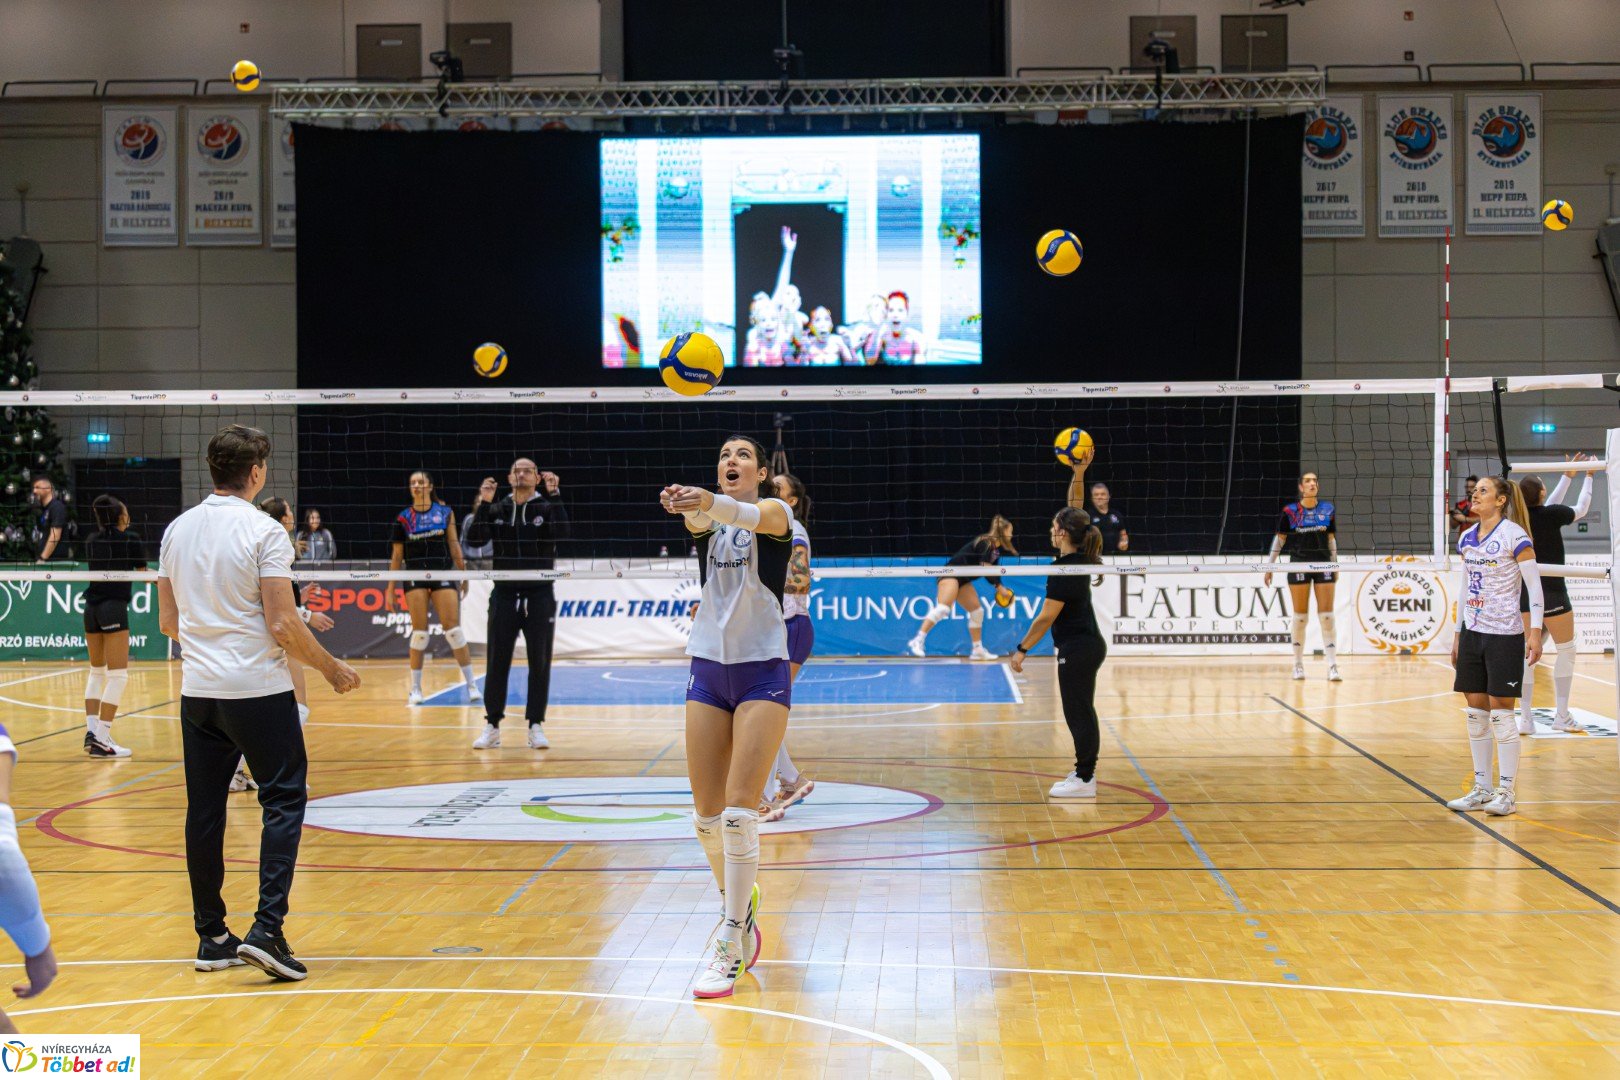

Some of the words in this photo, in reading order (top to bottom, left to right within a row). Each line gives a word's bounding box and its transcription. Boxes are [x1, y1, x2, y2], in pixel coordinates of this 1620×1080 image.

[1316, 182, 1336, 191] 2017
[1494, 180, 1514, 189] 2019
[46, 583, 152, 614] Ned
[1114, 573, 1291, 619] FATUM
[1373, 599, 1432, 612] VEKNI
[1115, 620, 1292, 632] PROPERTY
